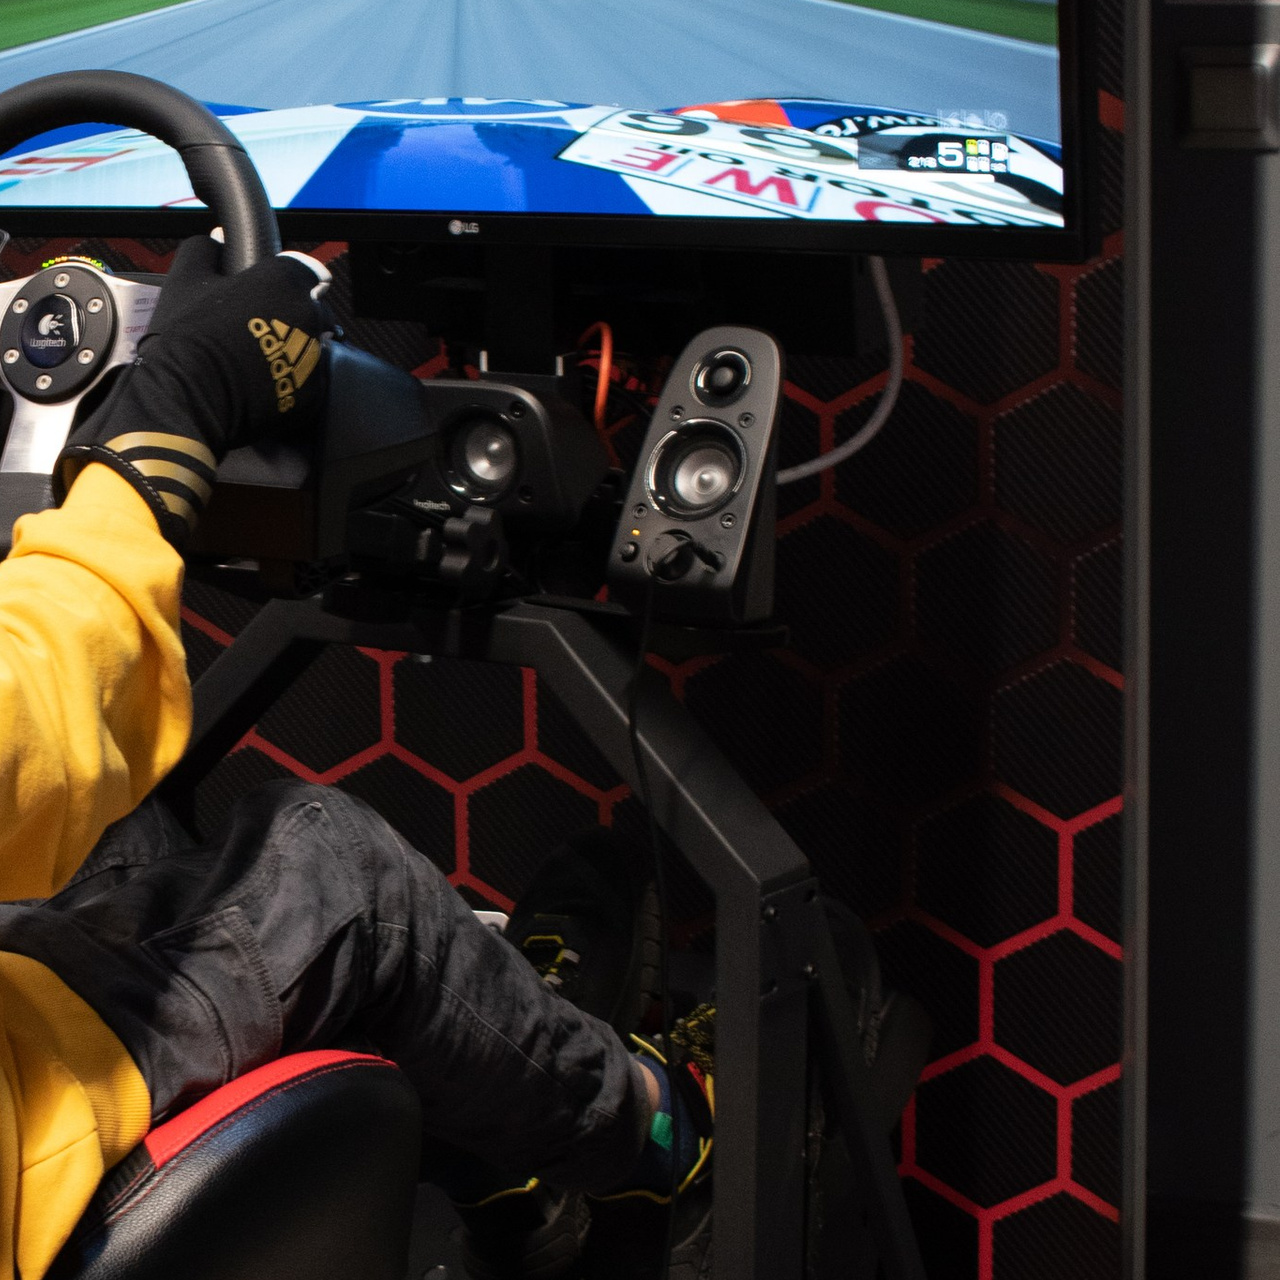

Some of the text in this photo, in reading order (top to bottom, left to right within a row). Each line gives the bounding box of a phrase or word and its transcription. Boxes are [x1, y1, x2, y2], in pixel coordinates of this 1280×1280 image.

[938, 142, 963, 167] 5
[29, 337, 67, 350] Logitech
[247, 317, 296, 413] adidas
